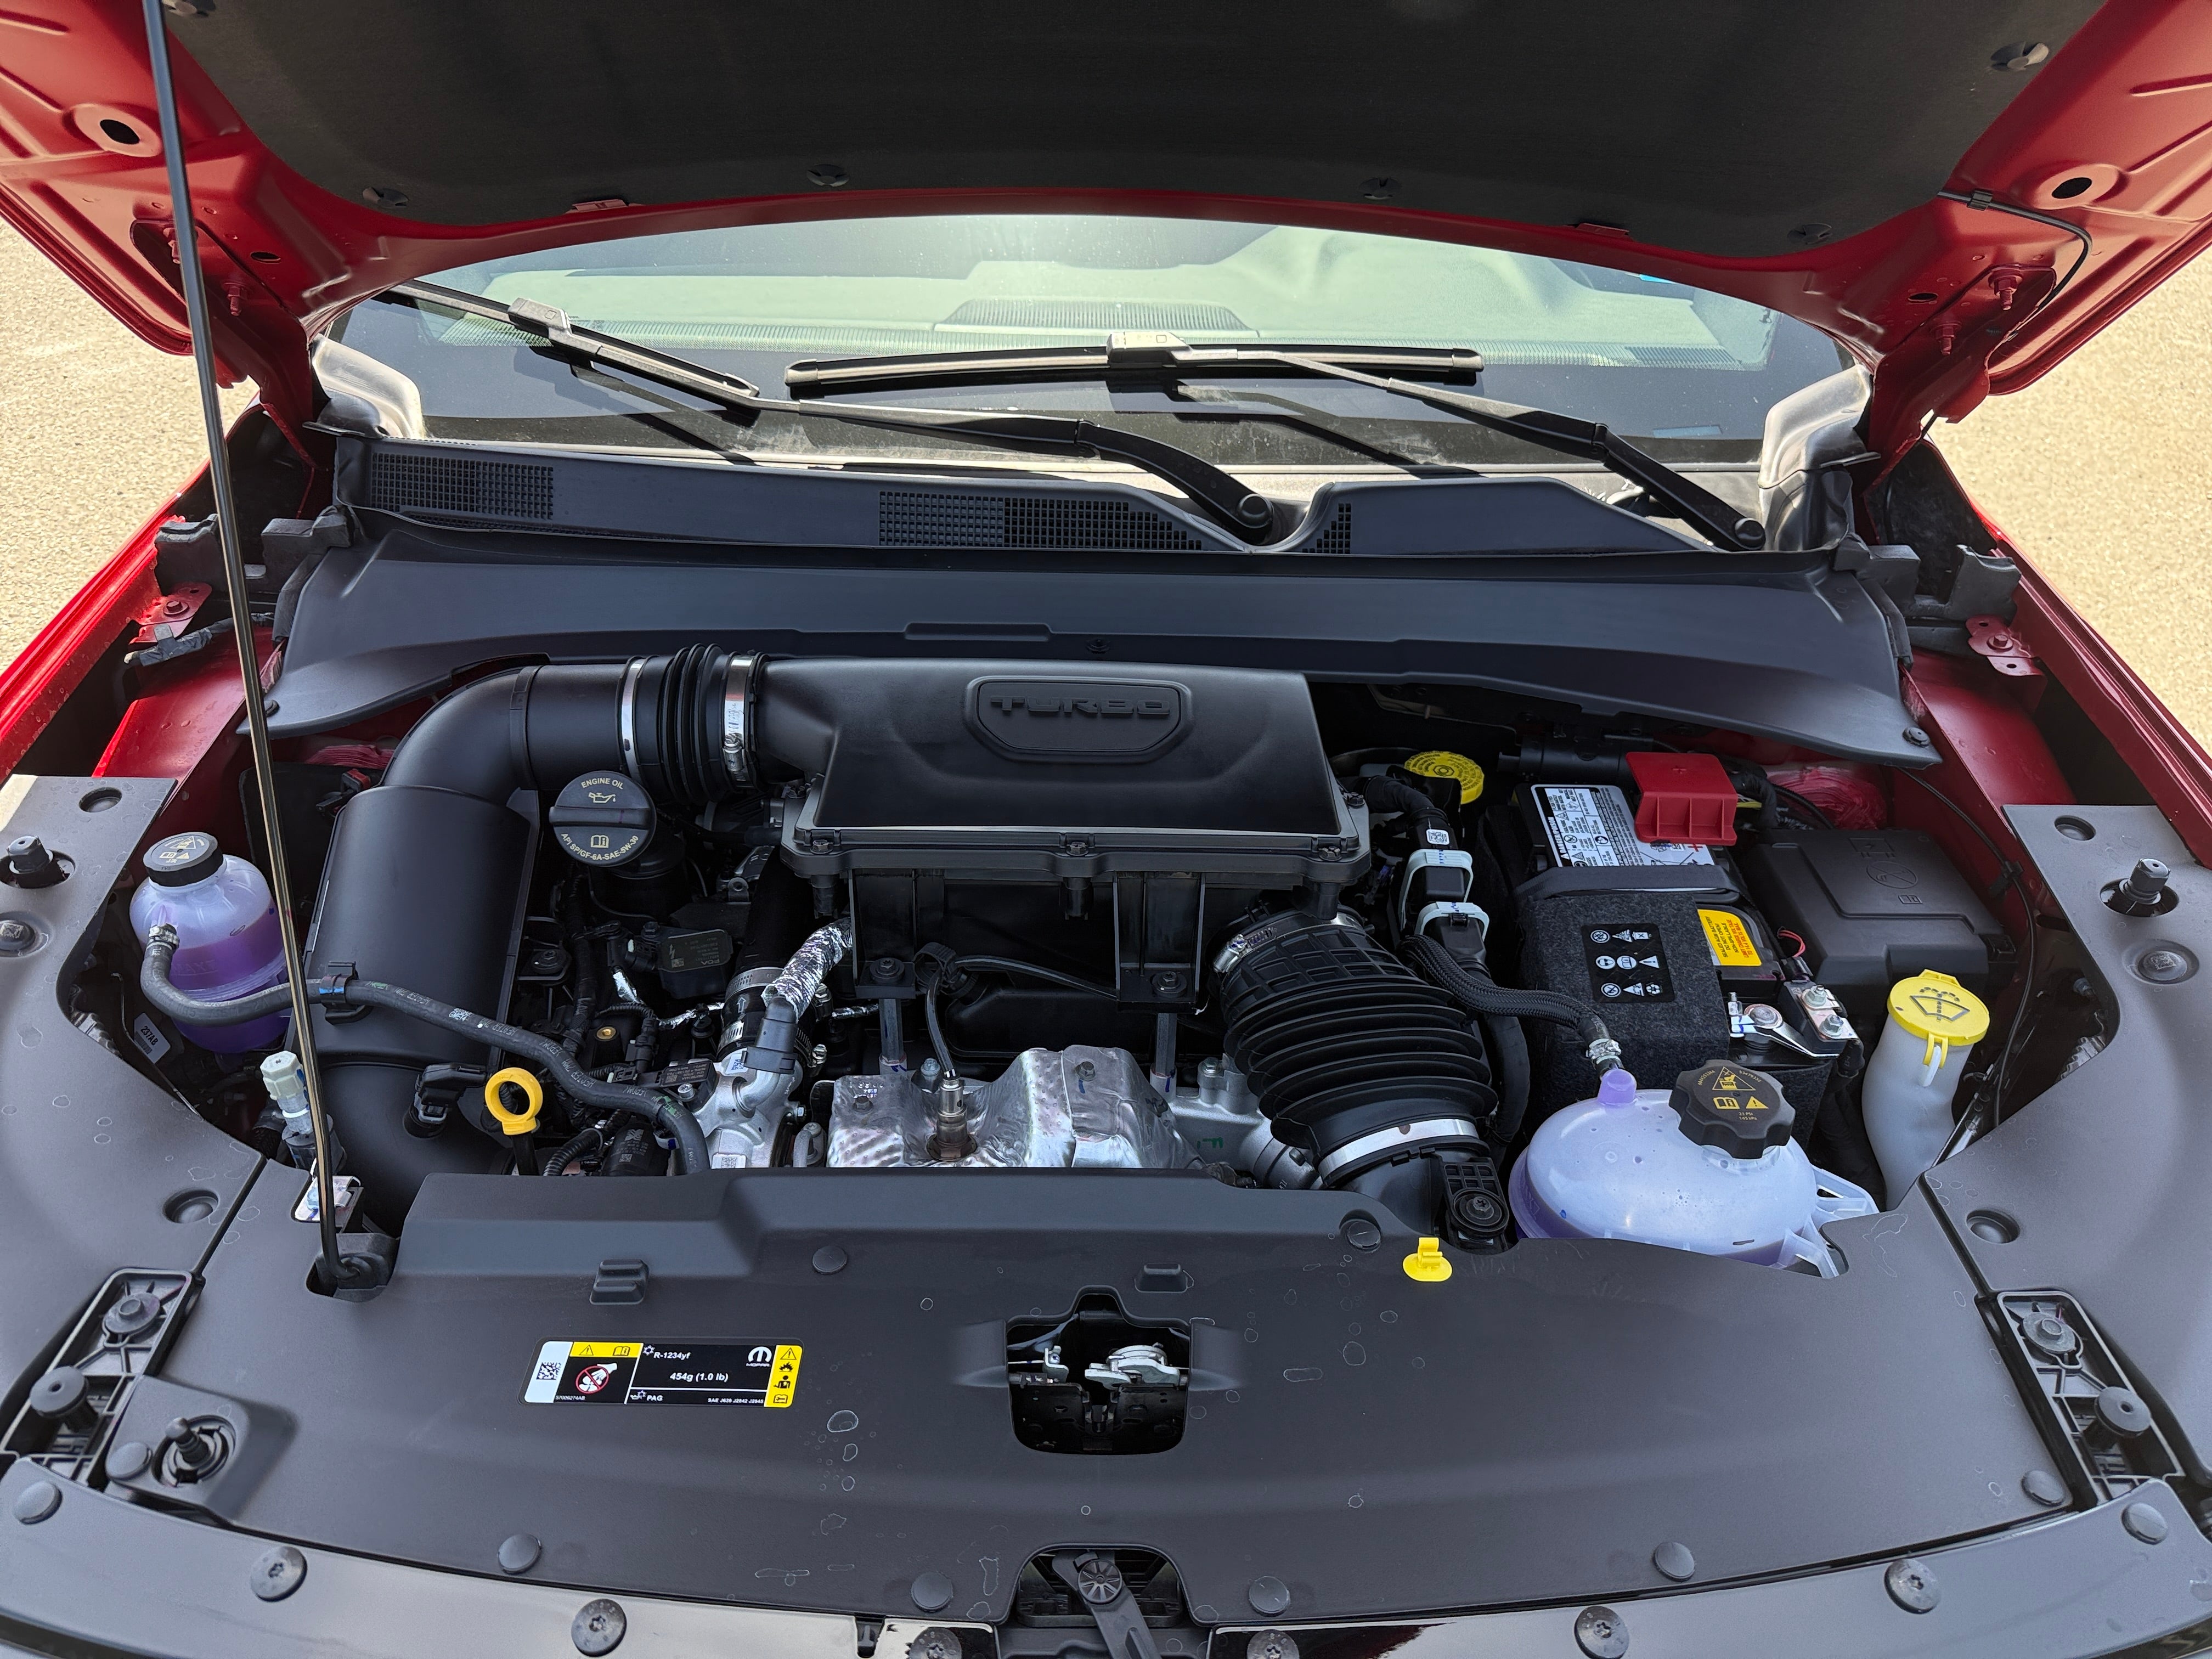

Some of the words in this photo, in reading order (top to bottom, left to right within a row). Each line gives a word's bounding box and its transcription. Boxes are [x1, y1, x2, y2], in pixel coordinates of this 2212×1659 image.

[990, 696, 1171, 715] TURBO
[581, 778, 611, 788] ENGINE
[612, 779, 624, 789] OIL
[561, 833, 572, 845] API
[1705, 916, 1716, 933] BATTERY
[1718, 943, 1728, 958] SEALED
[140, 1026, 158, 1046] 237AB
[653, 1352, 691, 1361] R-1234yf
[670, 1373, 693, 1382] 454g
[696, 1373, 714, 1382] (1.0
[715, 1373, 729, 1383] lb)
